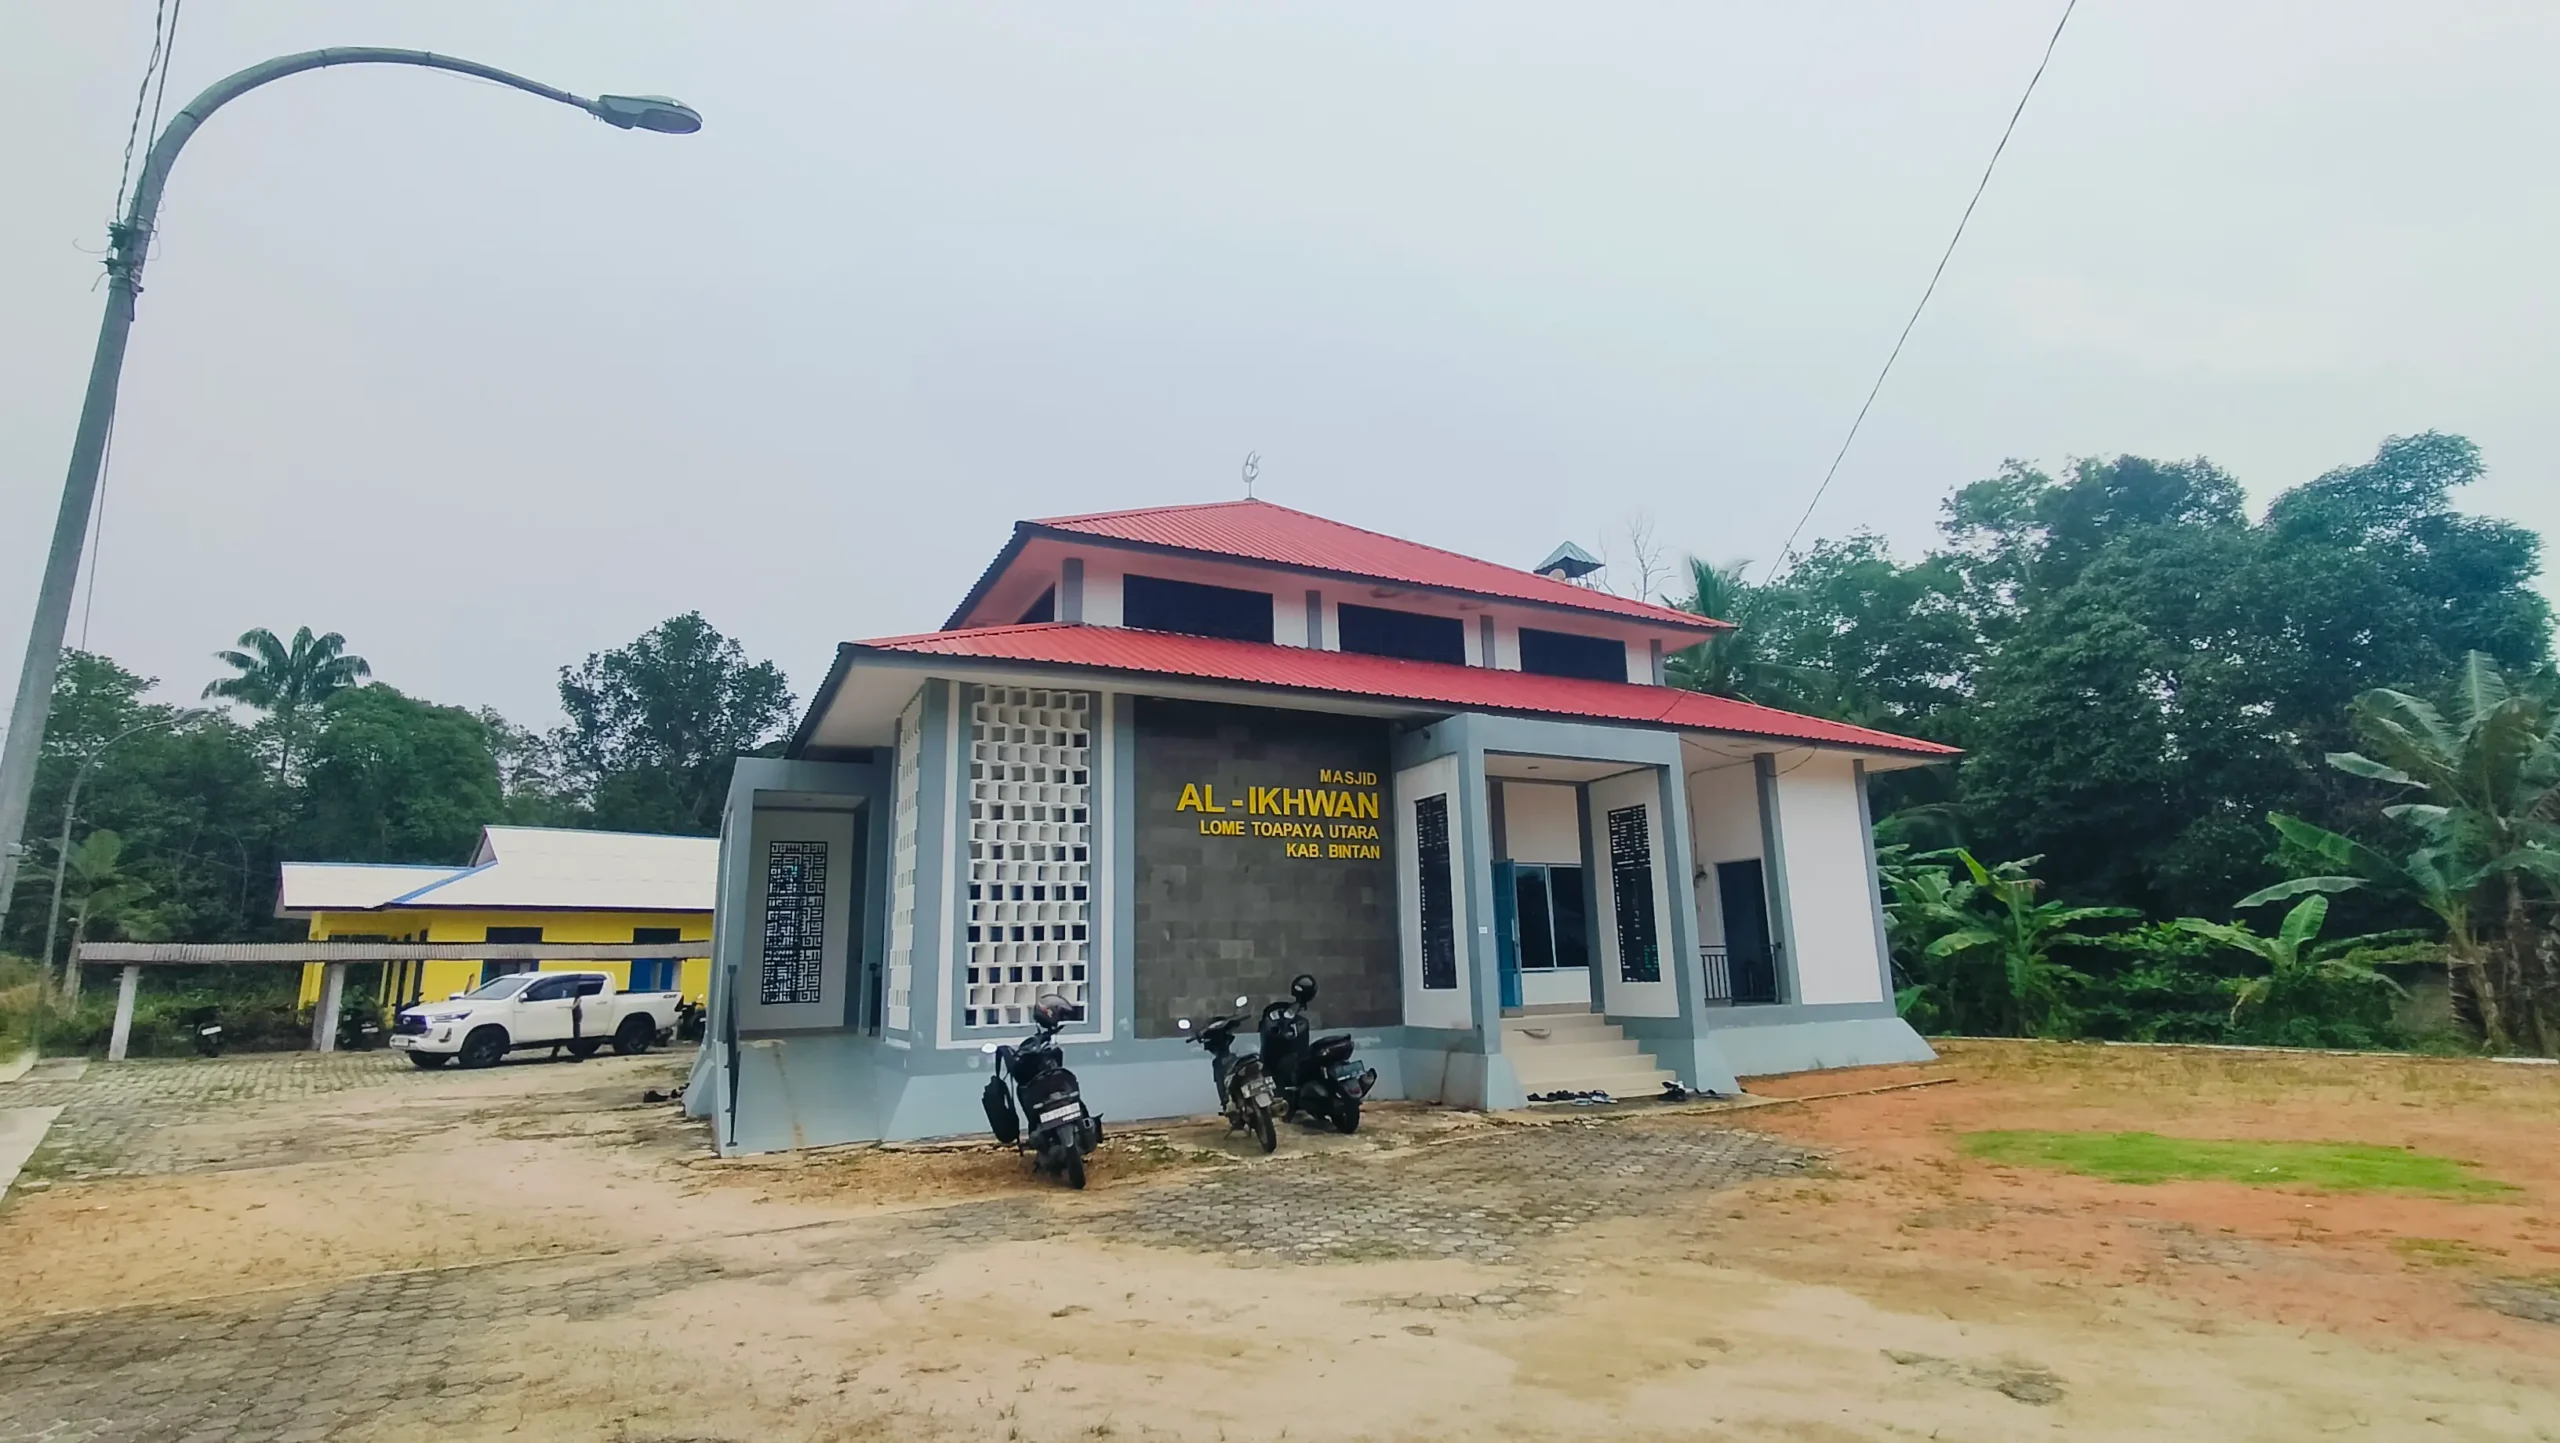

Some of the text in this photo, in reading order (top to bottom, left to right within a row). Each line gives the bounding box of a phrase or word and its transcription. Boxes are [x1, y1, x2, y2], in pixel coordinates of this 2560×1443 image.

[1320, 769, 1377, 786] MASJID
[1176, 783, 1226, 813] AL
[1248, 786, 1380, 819] IKHWAN
[1200, 819, 1379, 840] LOME TOAPAYA UTARA
[1286, 842, 1380, 859] KAB. BINTAN
